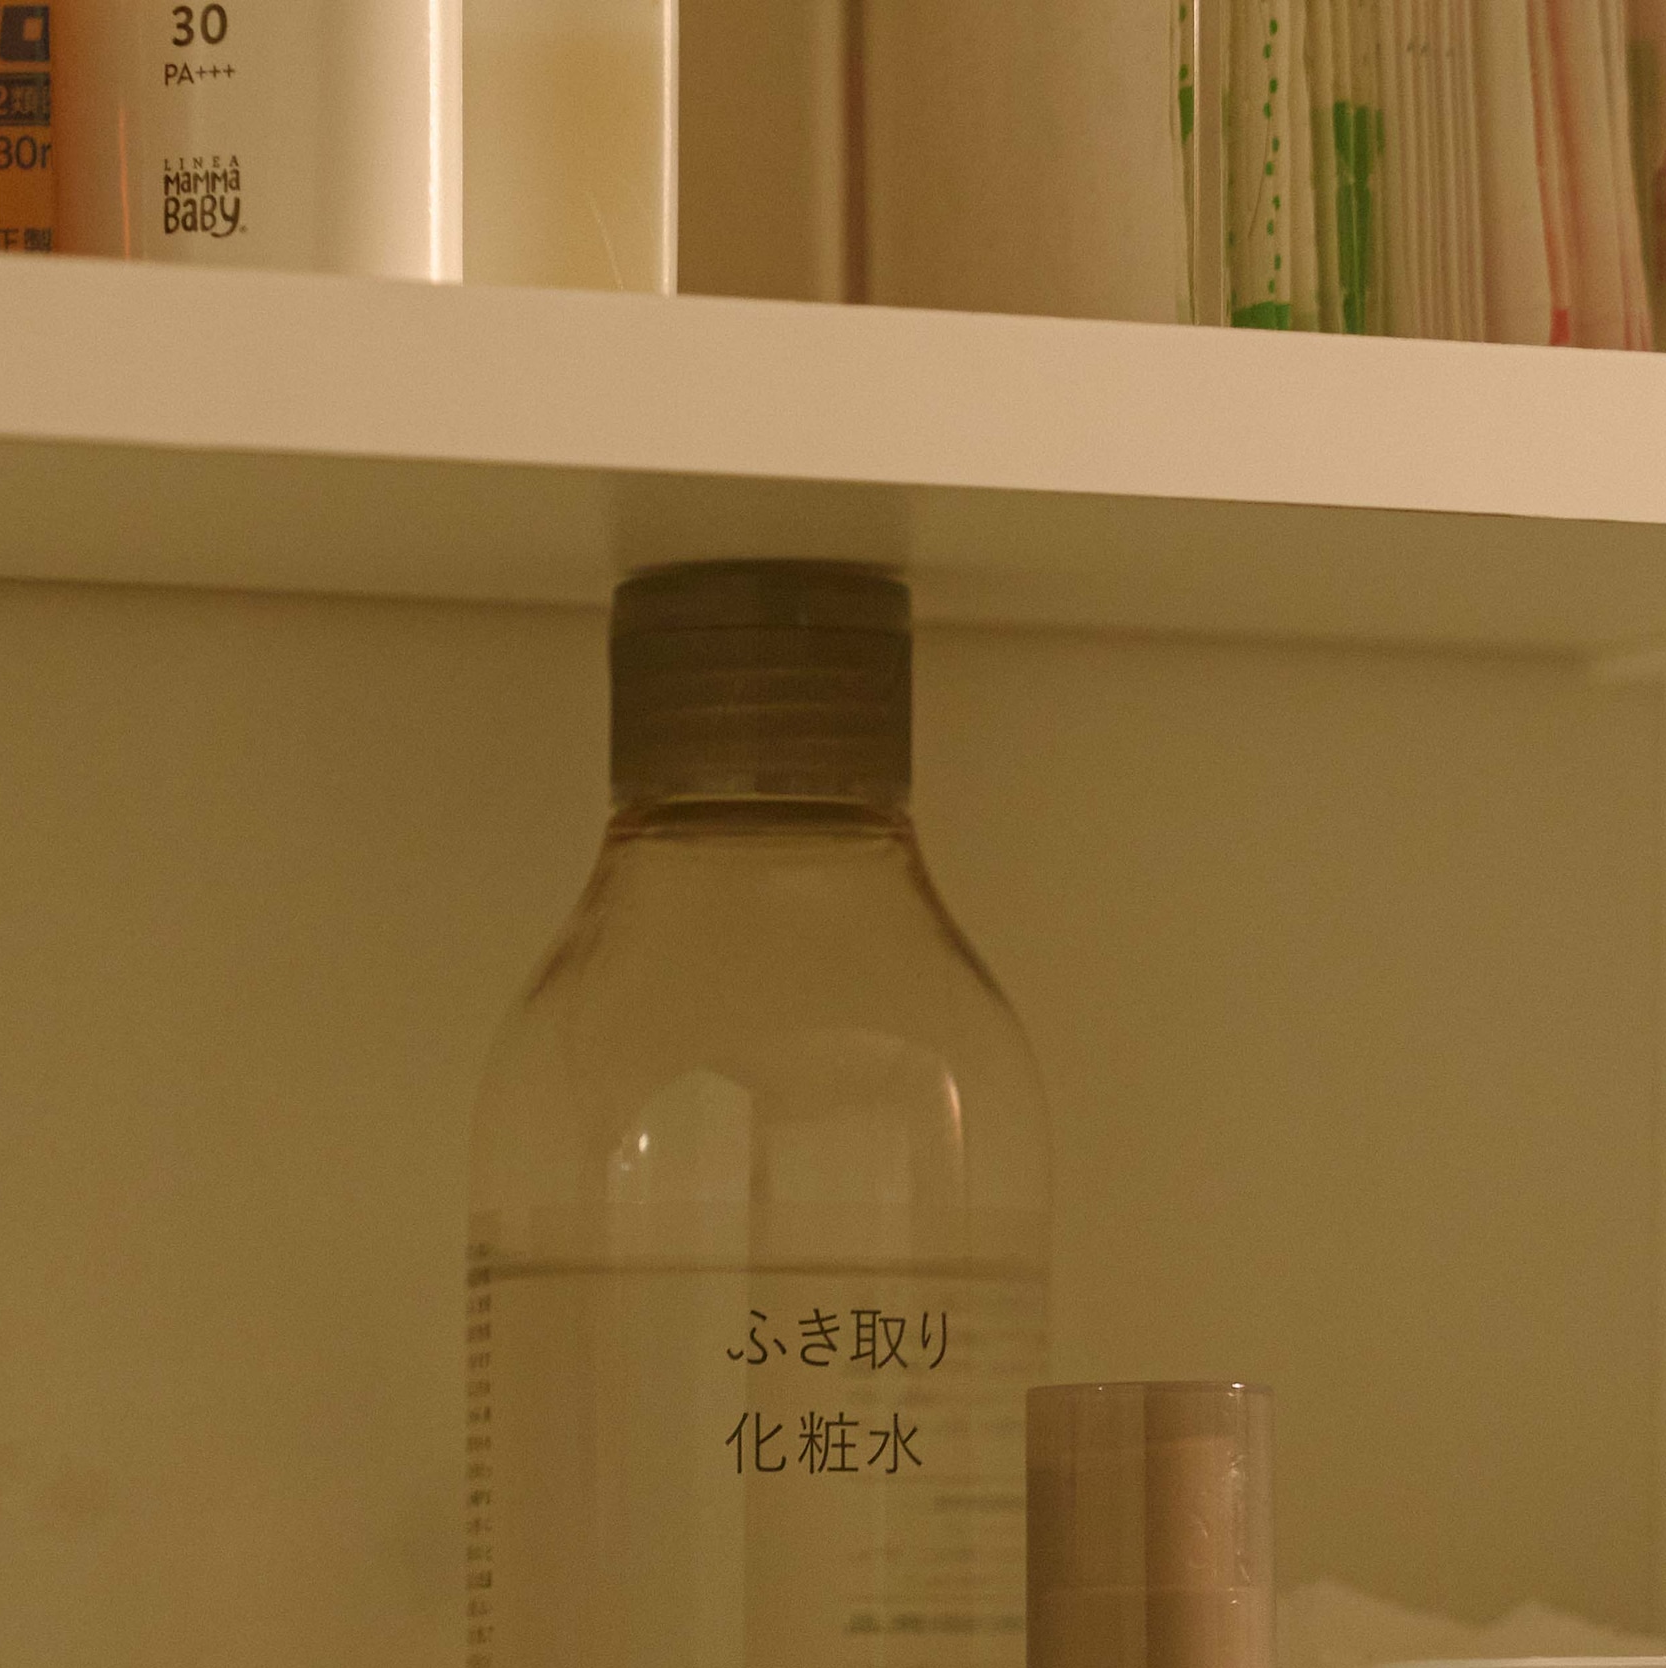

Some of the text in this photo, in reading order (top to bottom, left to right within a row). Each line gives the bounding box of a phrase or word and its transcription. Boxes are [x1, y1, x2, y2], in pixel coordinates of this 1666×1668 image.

[172, 3, 227, 47] 30
[164, 61, 235, 86] PA+++
[164, 155, 239, 172] LINEA
[726, 1308, 948, 1370] ふき取り
[725, 1411, 923, 1475] 化粧水
